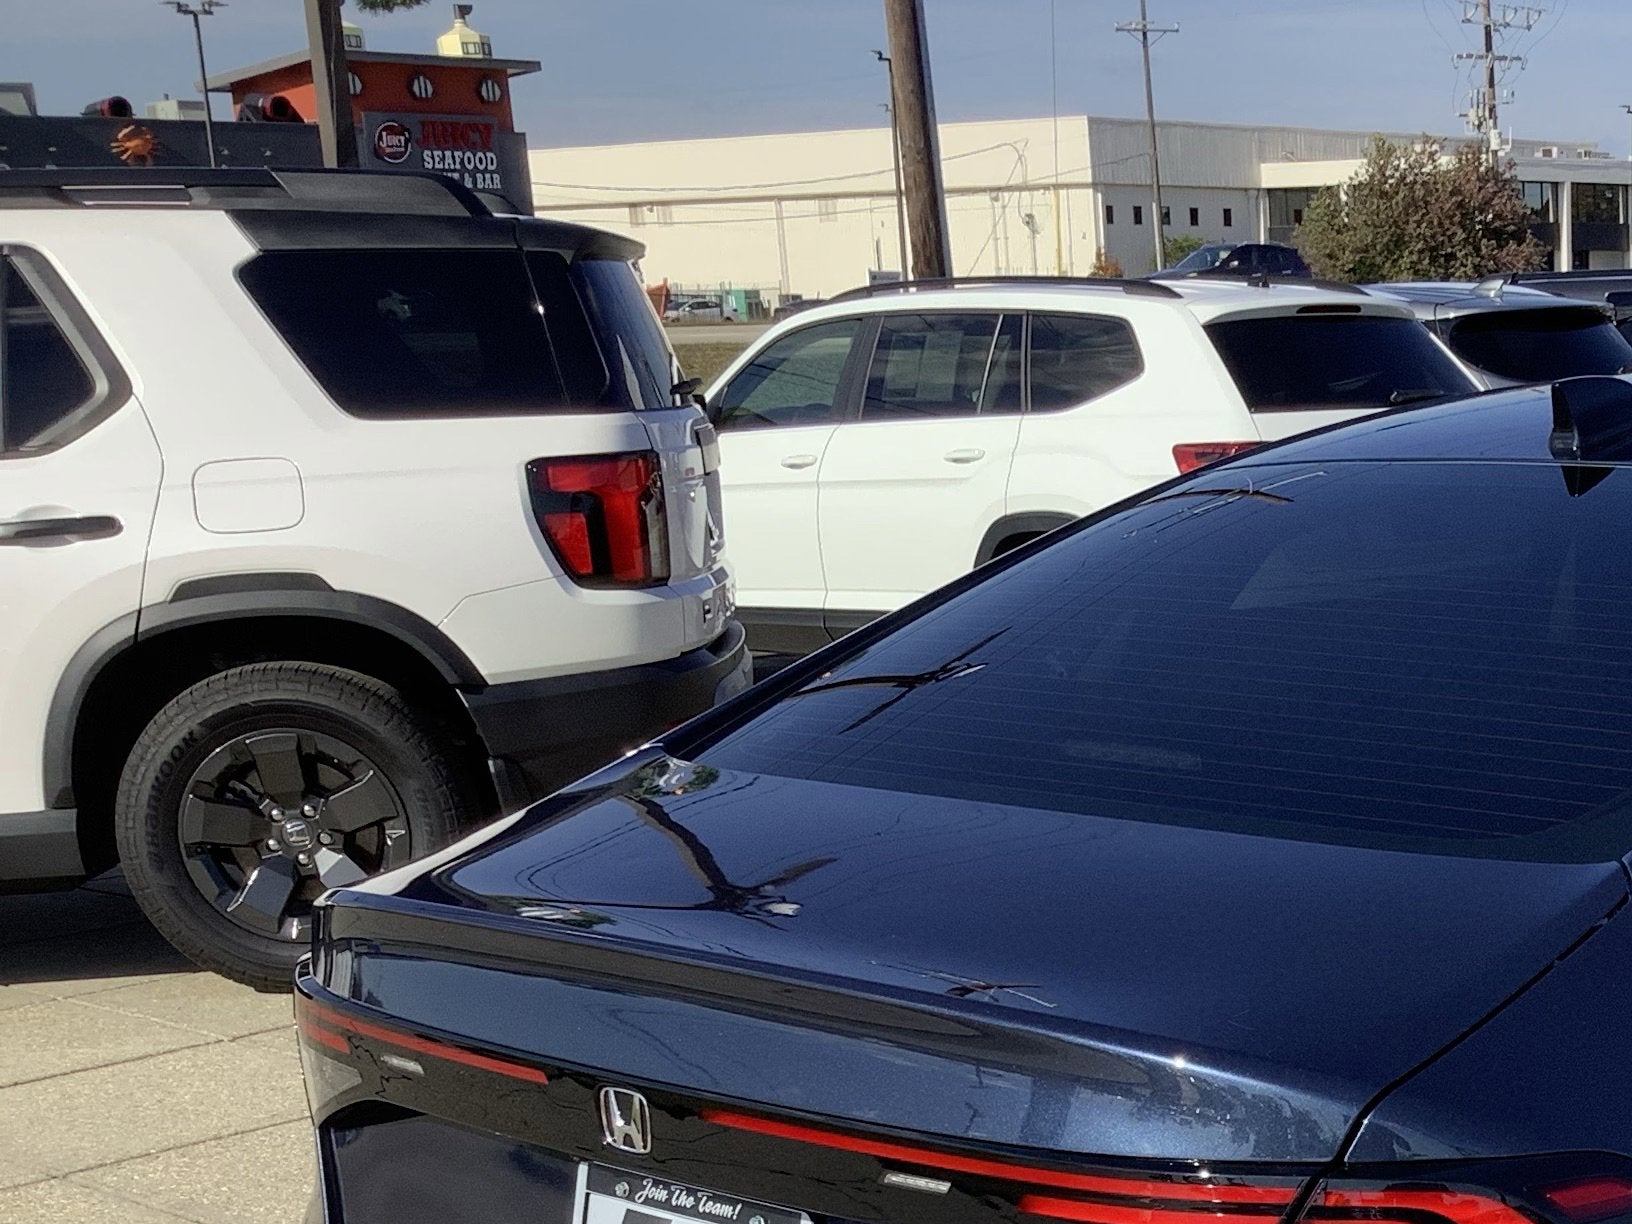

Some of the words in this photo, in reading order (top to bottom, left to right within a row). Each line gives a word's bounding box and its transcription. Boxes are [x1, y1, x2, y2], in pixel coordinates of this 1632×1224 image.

[415, 121, 493, 149] JUICY
[423, 151, 497, 170] SEAFOOD
[477, 173, 501, 189] BAR
[634, 1178, 669, 1204] Join
[671, 1186, 695, 1207] The
[697, 1191, 743, 1220] Team!
